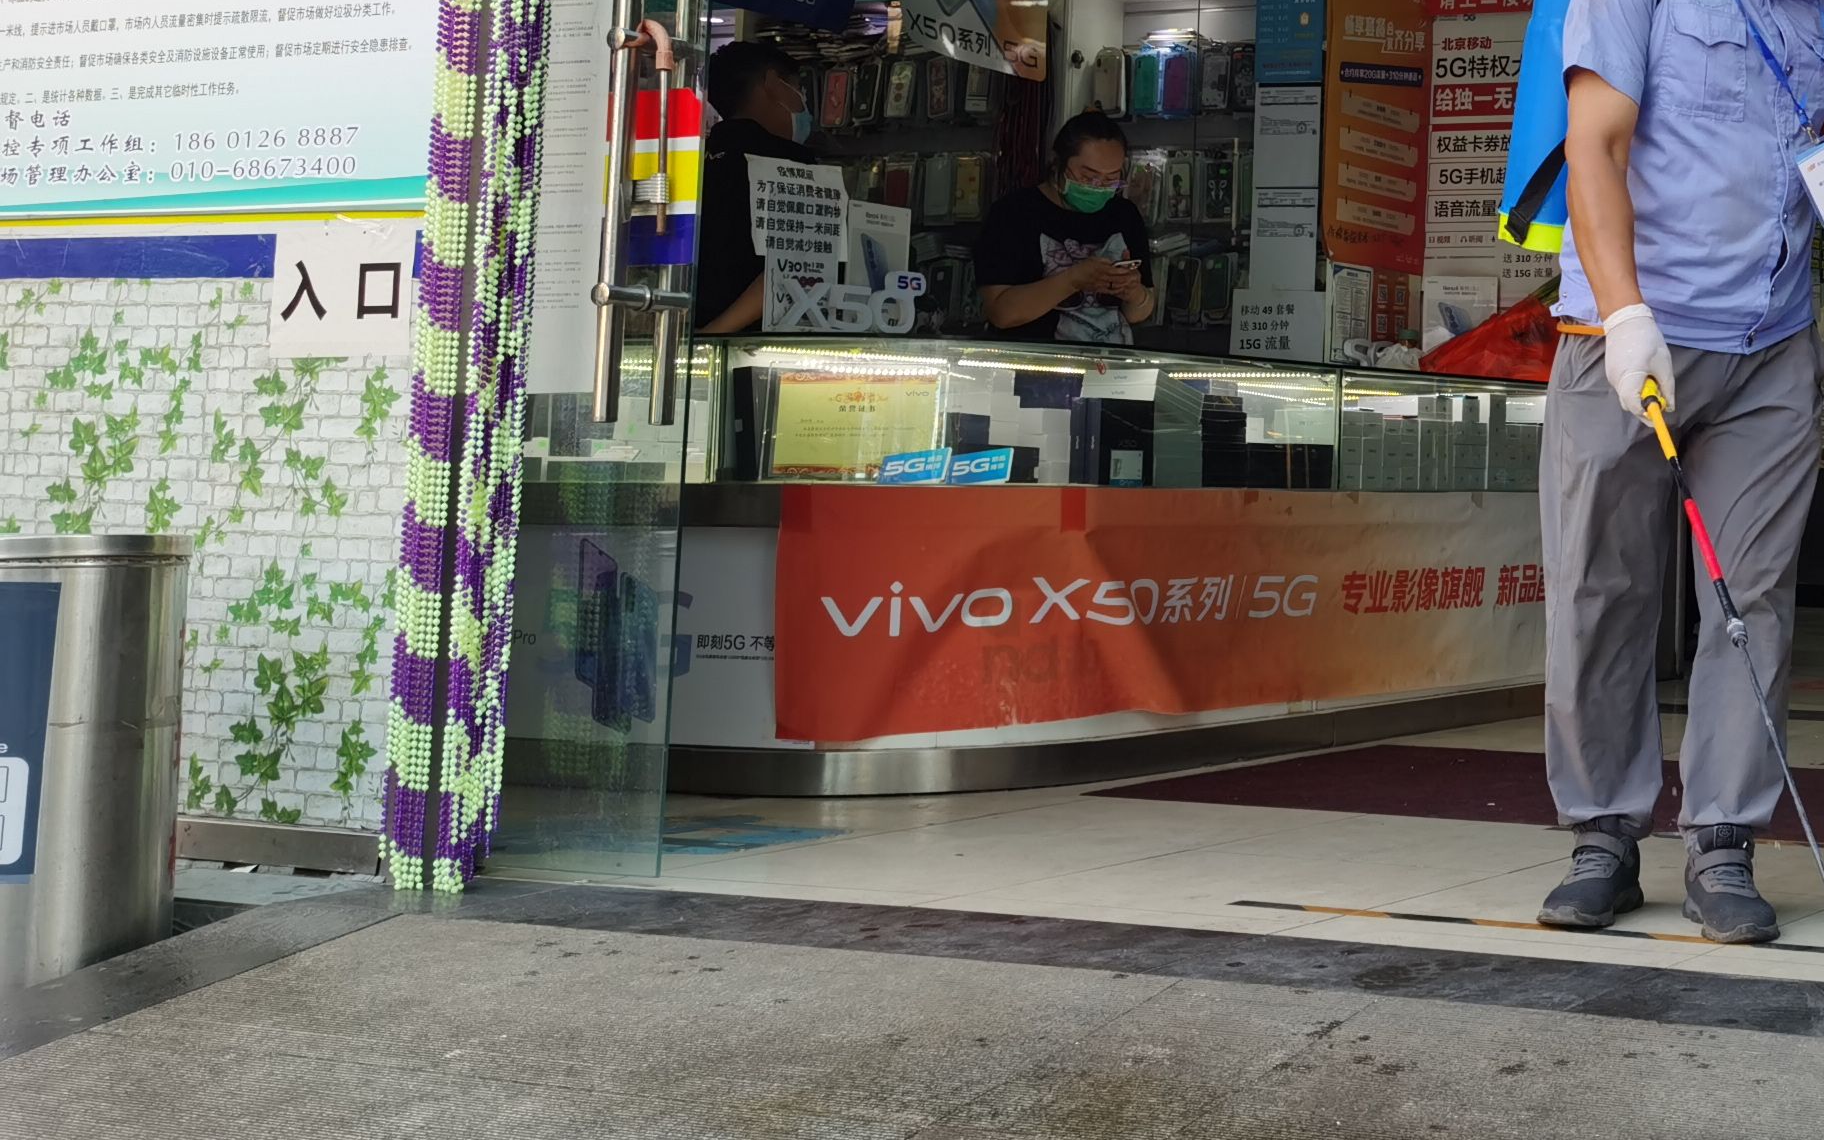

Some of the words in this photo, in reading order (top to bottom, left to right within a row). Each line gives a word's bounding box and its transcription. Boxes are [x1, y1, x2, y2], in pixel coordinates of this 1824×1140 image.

[906, 8, 992, 57] X50系列
[1441, 36, 1492, 52] 北京移动
[174, 131, 216, 152] 186
[227, 128, 287, 152] 0126
[297, 125, 360, 148] 8887
[281, 260, 402, 322] 入口
[898, 275, 922, 291] 5G
[1239, 339, 1261, 350] 15G
[1264, 336, 1291, 350] 流量
[905, 389, 930, 398] vivo
[883, 457, 926, 477] 5G
[951, 457, 990, 477] 5G
[1342, 565, 1486, 615] 专业影像旗舰
[821, 581, 1014, 637] vivo
[1029, 573, 1233, 629] X50系列
[1248, 574, 1319, 619] 5G
[697, 634, 745, 650] 即刻5G
